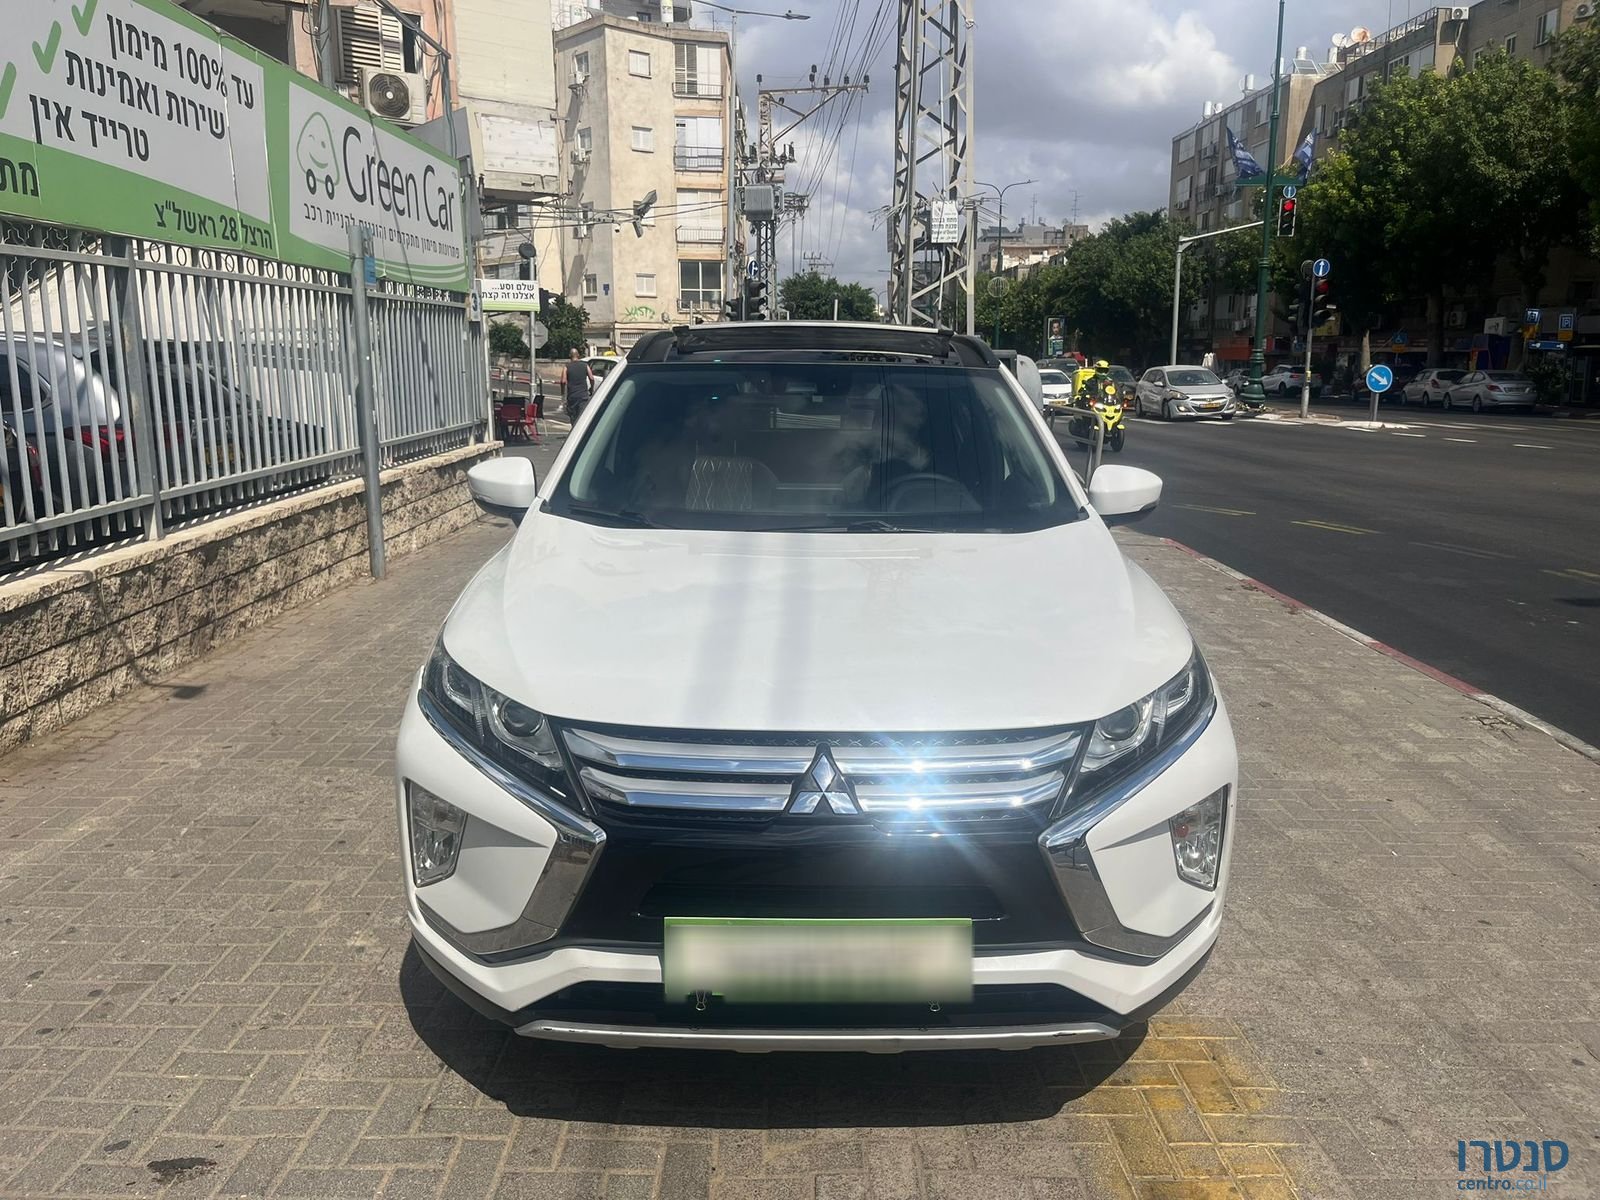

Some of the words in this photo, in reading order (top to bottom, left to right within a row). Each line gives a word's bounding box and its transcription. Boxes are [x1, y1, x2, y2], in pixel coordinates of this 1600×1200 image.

[107, 13, 167, 71] מימון
[65, 49, 160, 116] ואמינות
[174, 43, 228, 97] 100%
[231, 74, 254, 109] עד
[29, 94, 75, 144] אין
[166, 89, 225, 139] שירות
[82, 110, 149, 162] טרייד
[343, 126, 420, 221] Green
[423, 165, 455, 232] Car
[220, 215, 238, 242] 28
[304, 203, 323, 223] רכב
[241, 219, 273, 250] הרצל
[389, 228, 419, 250] מתקדמים
[482, 291, 499, 300] קצת
[512, 291, 535, 299] אצלנו
[516, 282, 534, 291] שלם
